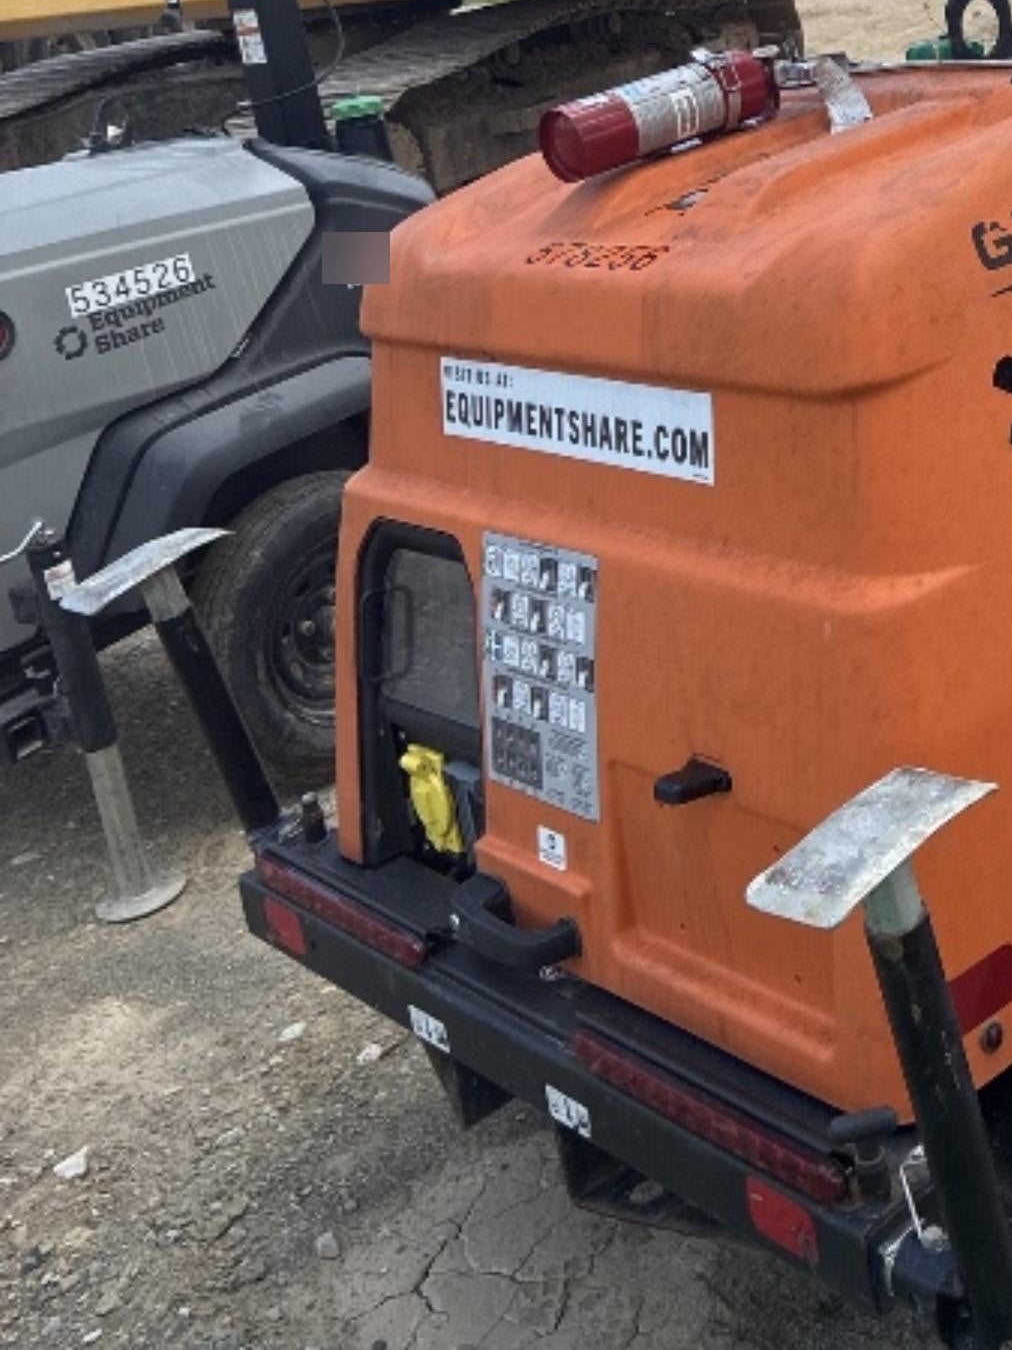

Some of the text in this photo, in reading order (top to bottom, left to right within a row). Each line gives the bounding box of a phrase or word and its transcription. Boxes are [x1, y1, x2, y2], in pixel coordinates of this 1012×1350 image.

[71, 257, 189, 313] 534526
[87, 273, 216, 332] Equipment
[95, 318, 166, 354] Share
[445, 390, 710, 469] EQUIPMENTSHARE.COM
